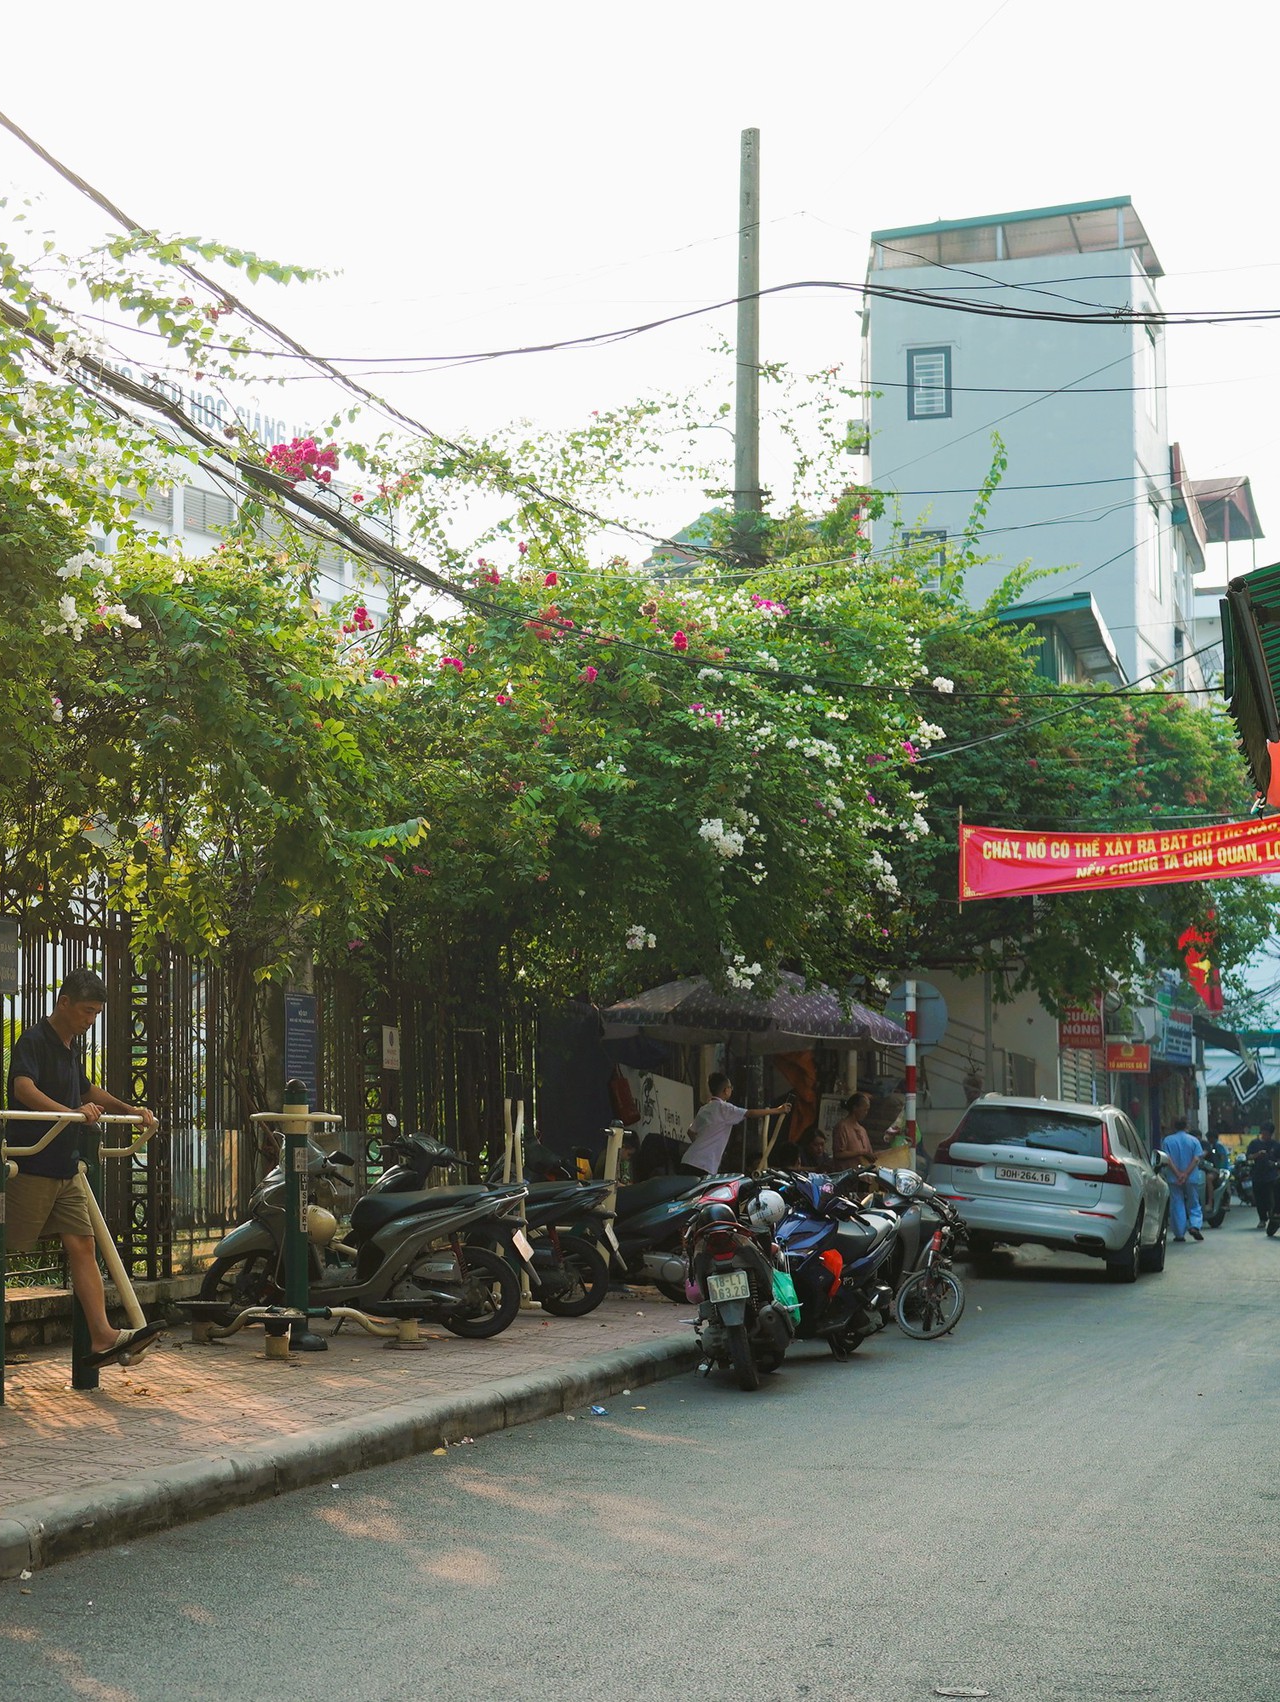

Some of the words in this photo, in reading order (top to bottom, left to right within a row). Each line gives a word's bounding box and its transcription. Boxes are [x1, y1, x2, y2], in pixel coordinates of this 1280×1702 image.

[982, 839, 1021, 860] CHÁY,
[1026, 836, 1047, 859] NỔ
[1074, 836, 1100, 858] THỂ
[1104, 838, 1132, 857] XẢY
[1137, 839, 1156, 854] RA
[1163, 854, 1179, 870] TA
[1184, 845, 1212, 868] CHỦ
[1217, 842, 1262, 866] QUAN,
